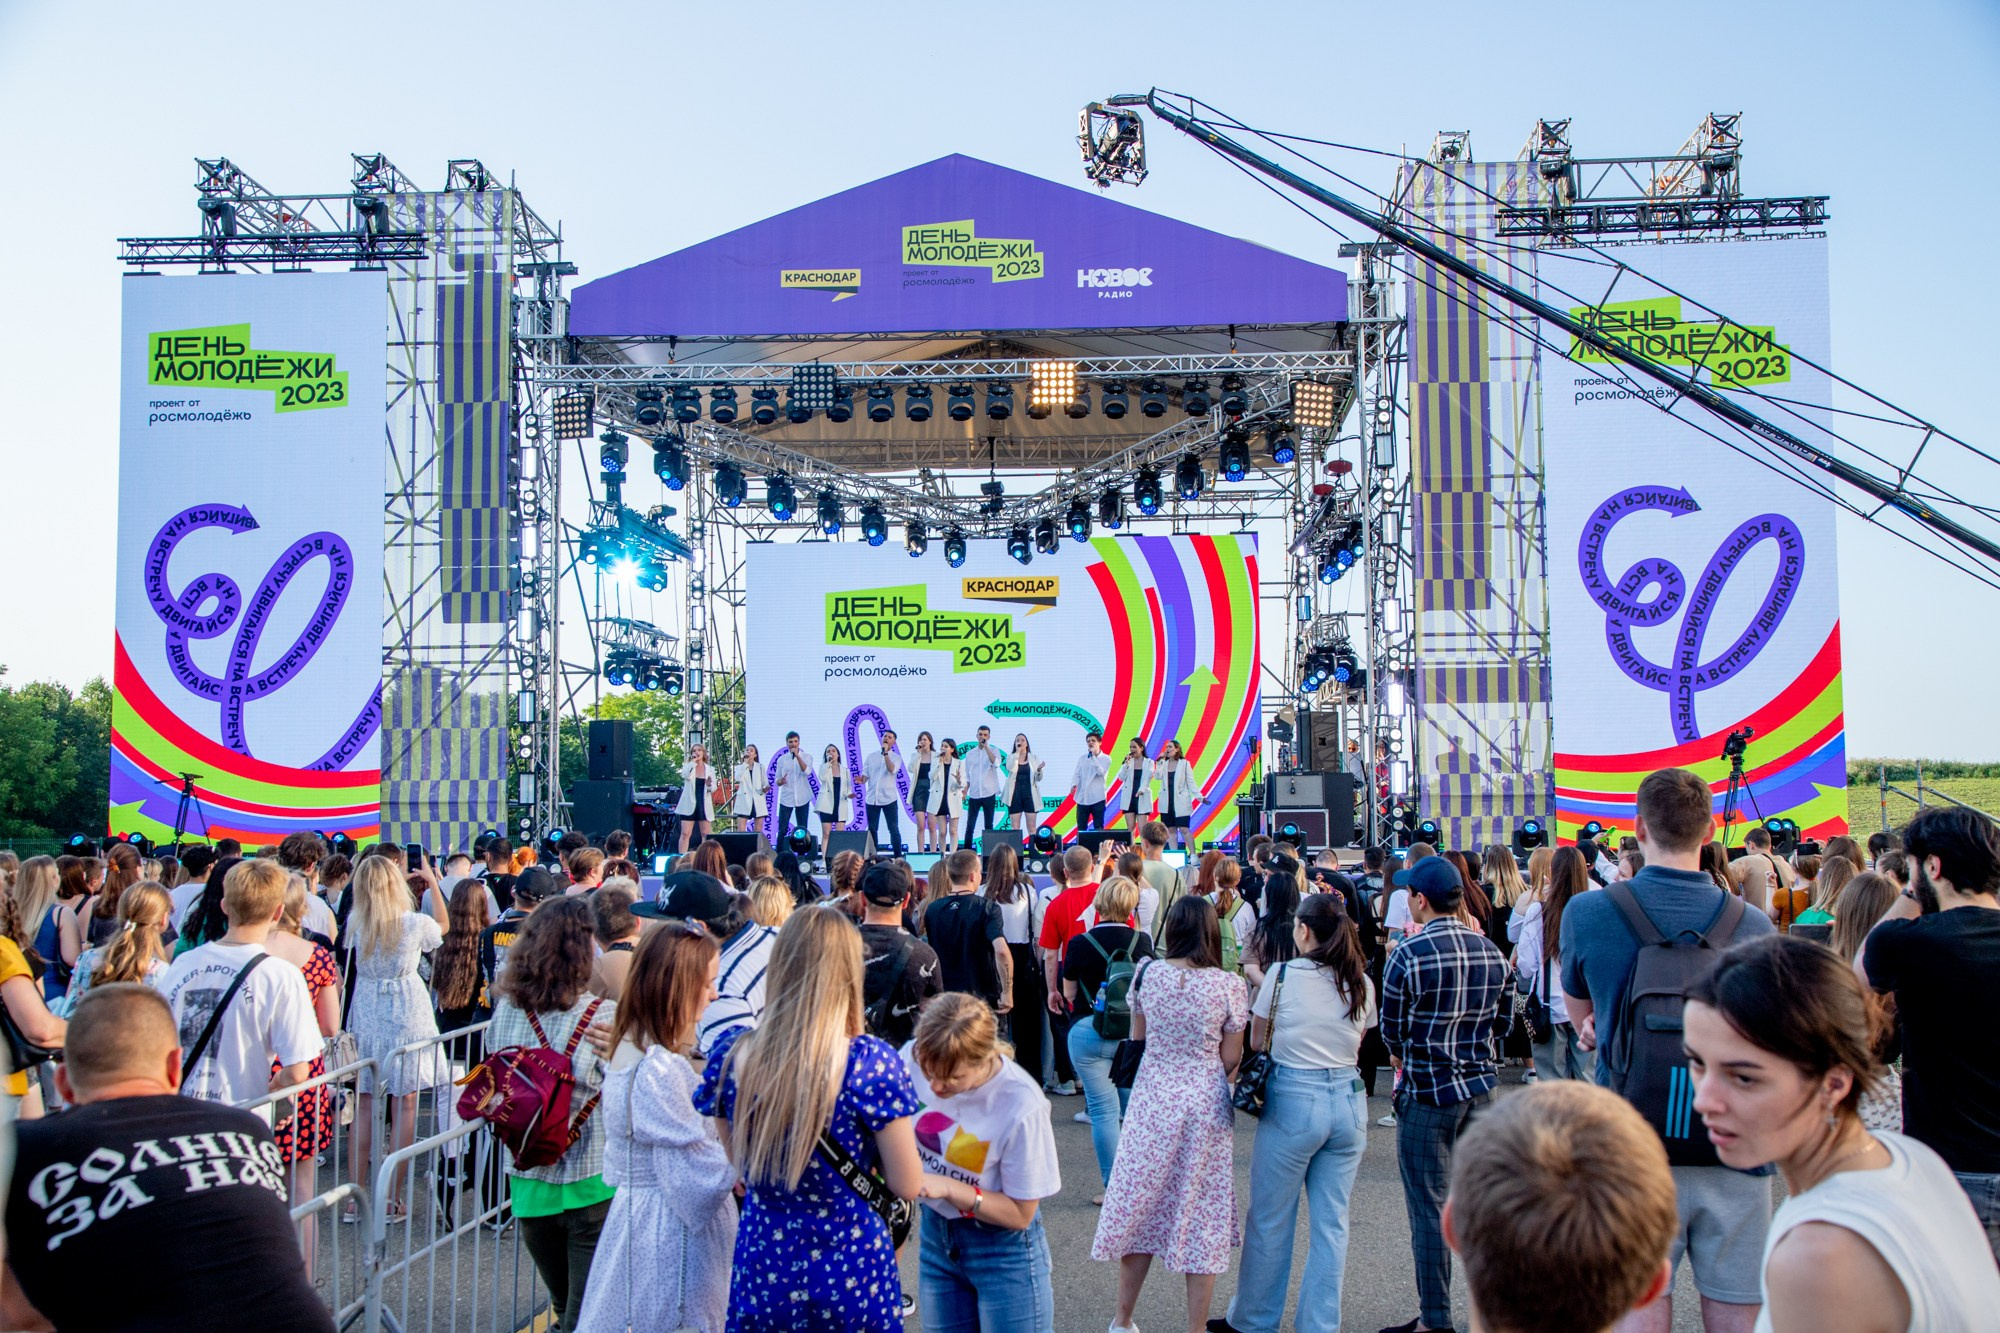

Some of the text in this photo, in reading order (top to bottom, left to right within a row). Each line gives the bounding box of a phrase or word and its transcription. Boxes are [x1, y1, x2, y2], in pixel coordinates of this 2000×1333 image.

[907, 229, 971, 247] ДЕНЬ
[907, 241, 1032, 262] МОЛОДЁЖИ
[785, 272, 857, 284] КРАСНОДАР
[903, 270, 928, 278] проект
[996, 260, 1041, 278] 2023
[903, 277, 975, 289] росмолодёжь
[1098, 291, 1133, 299] РАДИО
[154, 336, 246, 361] ДЕНЬ
[154, 354, 333, 384] МОЛОДЁЖИ
[1717, 355, 1787, 383] 2023
[281, 381, 344, 406] 2023
[1574, 377, 1629, 388] проект от
[149, 399, 200, 410] проект от
[149, 409, 252, 426] росмолодёжь
[1598, 500, 1621, 520] НА
[165, 517, 187, 538] НА
[1777, 526, 1797, 550] НА
[329, 544, 347, 567] НА
[1584, 523, 1606, 589] ВСТРЕЧУ
[1719, 521, 1771, 573] ВСТРЕЧУ
[149, 539, 171, 602] ВСТРЕЧУ
[273, 538, 323, 586] ВСТРЕЧУ
[1657, 562, 1678, 585] НА
[215, 577, 235, 600] НА
[966, 579, 1055, 593] КРАСНОДАР
[1760, 556, 1799, 632] ДВИГАЙСЯ
[306, 571, 347, 645] ДВИГАЙСЯ
[831, 596, 922, 621] ДЕНЬ
[1597, 590, 1679, 620] ДВИГАЙСЯ
[1684, 570, 1722, 647] ДВИГАЙСЯ
[160, 604, 235, 633] ДВИГАЙСЯ
[237, 585, 276, 659] ДВИГАЙСЯ
[831, 615, 1010, 644] МОЛОДЁЖИ
[824, 655, 876, 665] проект от
[959, 642, 1022, 666] 2023
[1610, 632, 1672, 686] ДВИГАЙС
[1680, 650, 1694, 671] НА
[1707, 628, 1761, 681] ВСТРЕЧУ
[169, 643, 223, 696] ДВИГАЙС
[231, 661, 245, 682] НА
[257, 642, 308, 692] ВСТРЕЧУ
[824, 665, 928, 682] росмолодёжь
[227, 685, 243, 748] ВСТРЕЧУ
[987, 705, 1011, 714] ДЕНЬ
[1013, 704, 1072, 716] МОЛОДЁЖИ
[1072, 711, 1091, 727] 2023
[1678, 675, 1697, 741] ВСТРЕЧУ
[332, 708, 377, 764] ВСТРЕЧУ
[847, 727, 856, 747] 2023
[170, 965, 254, 1006] ADLER-APOTEKE
